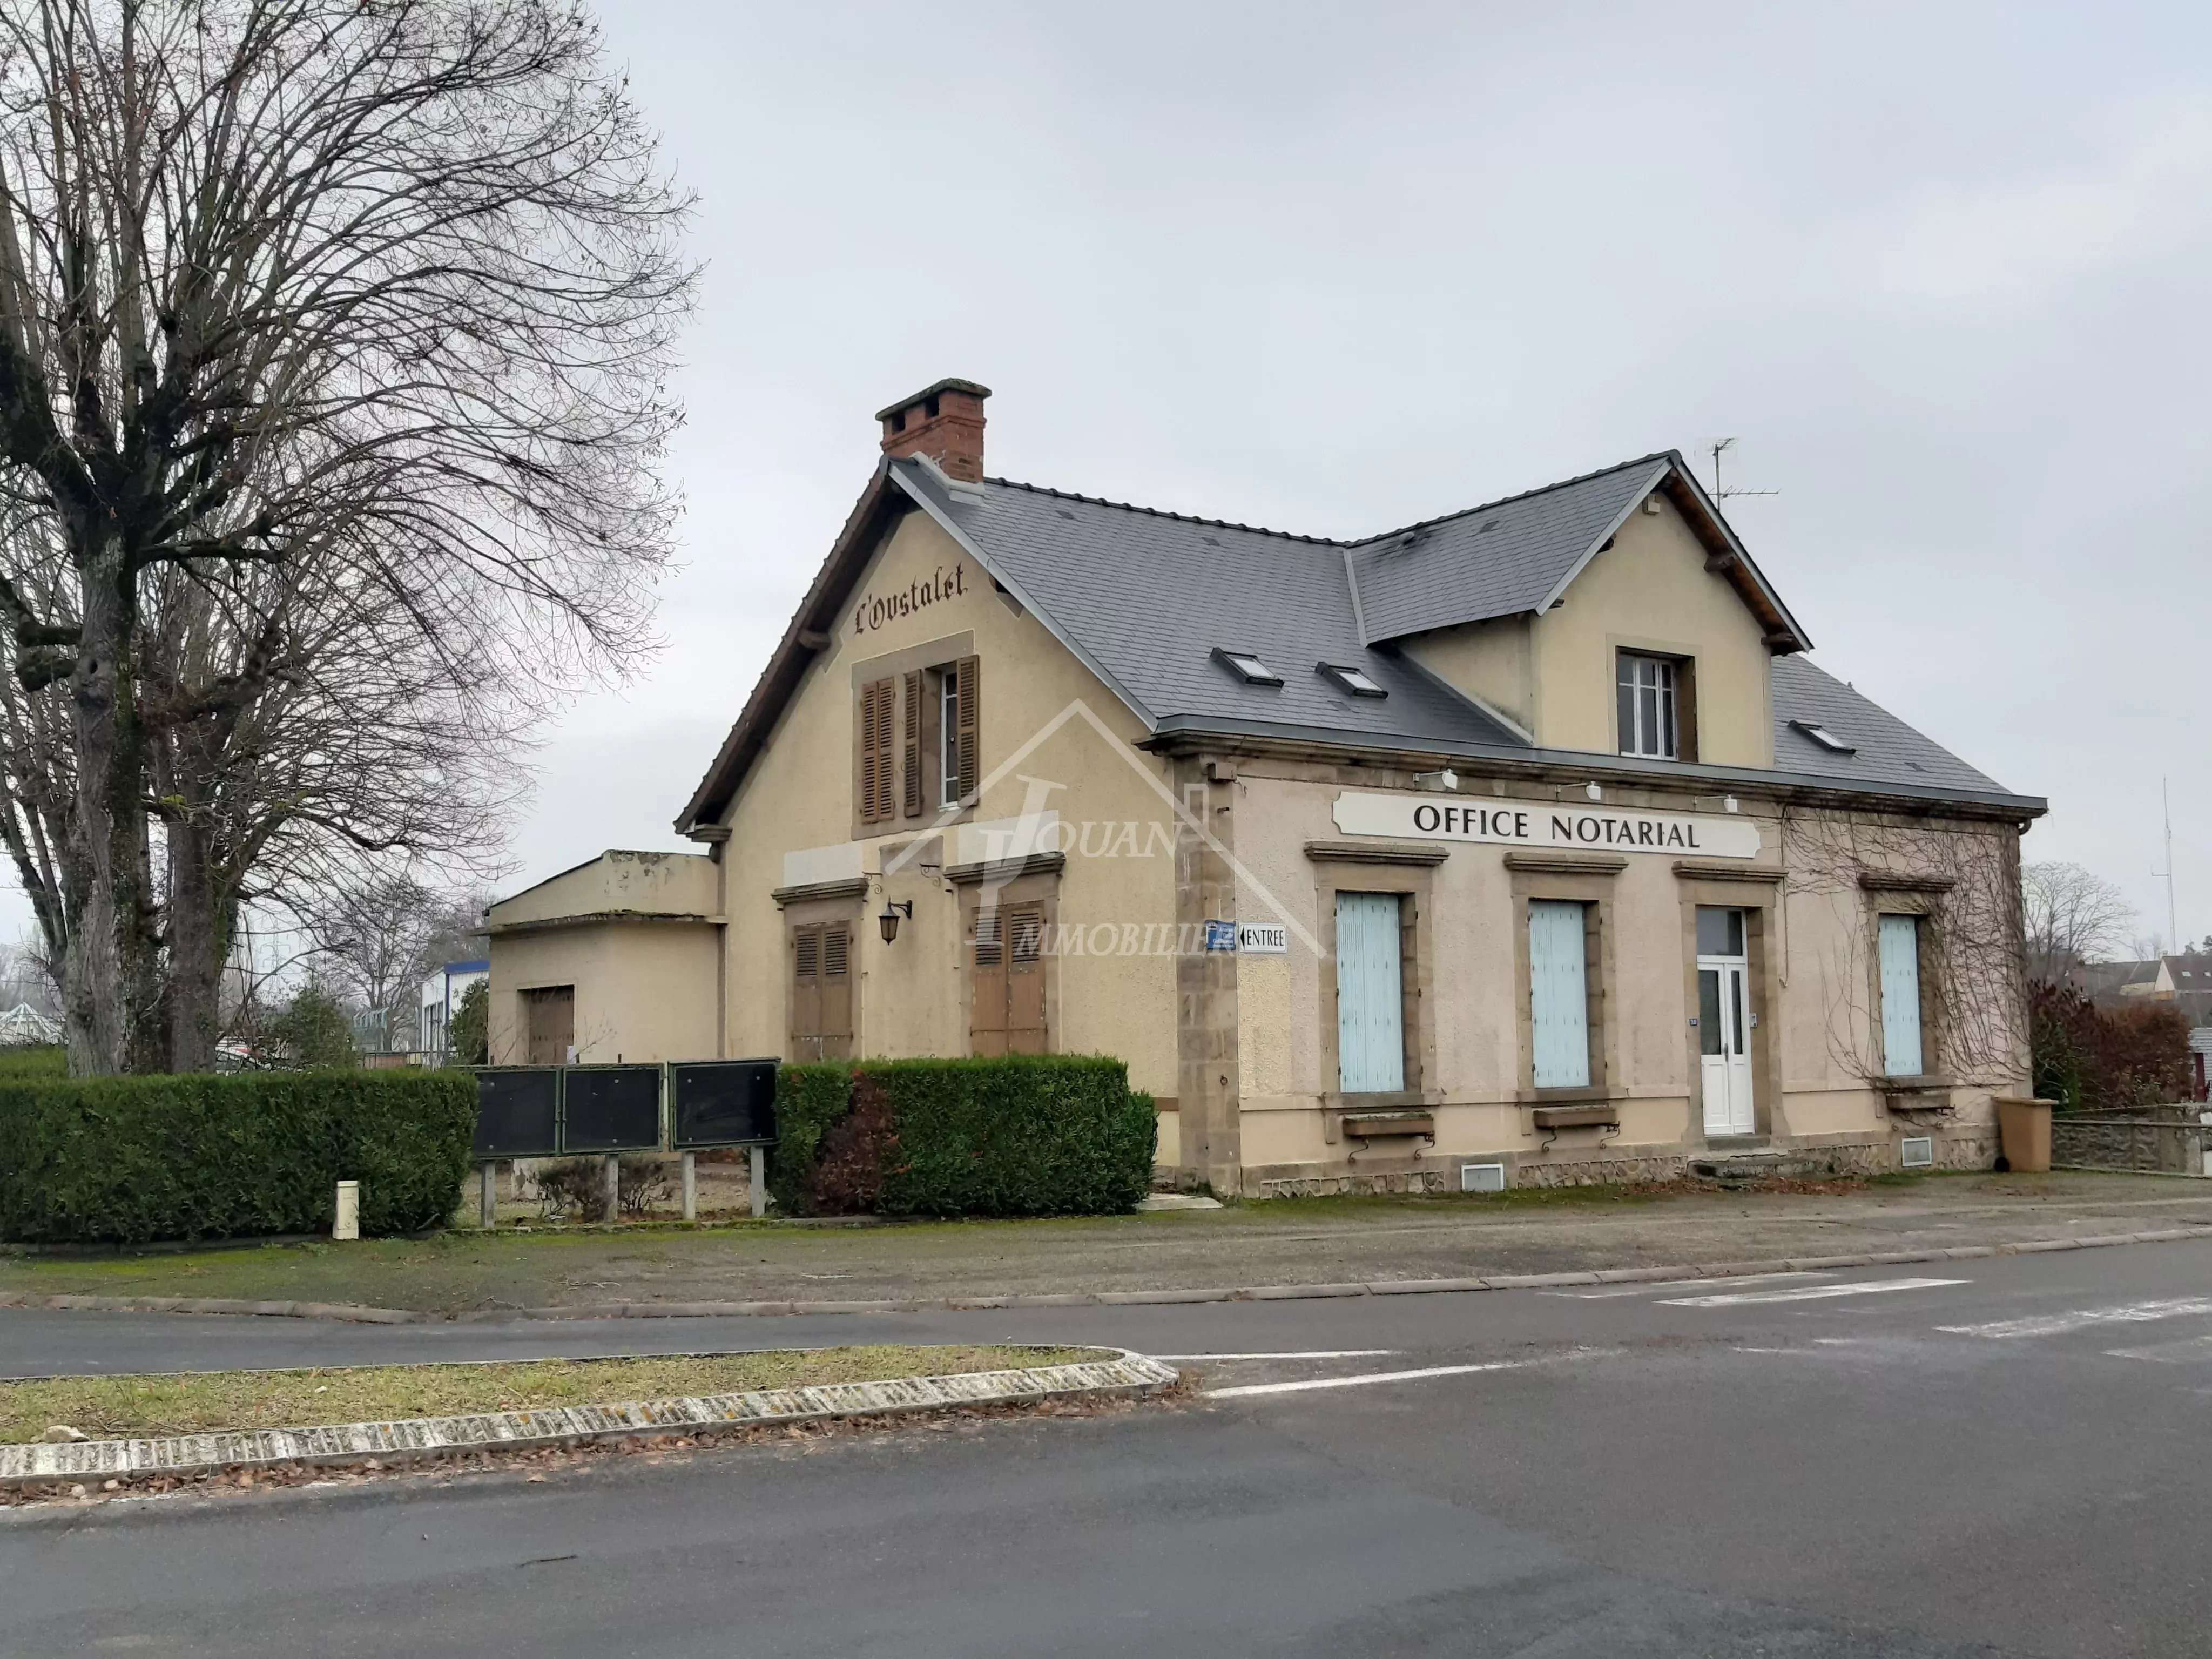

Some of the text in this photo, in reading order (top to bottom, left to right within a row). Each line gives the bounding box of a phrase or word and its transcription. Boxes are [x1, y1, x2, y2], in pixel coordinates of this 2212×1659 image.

[1413, 805, 1700, 848] OFFICE NOTARIAL
[1247, 929, 1284, 947] ENTREE
